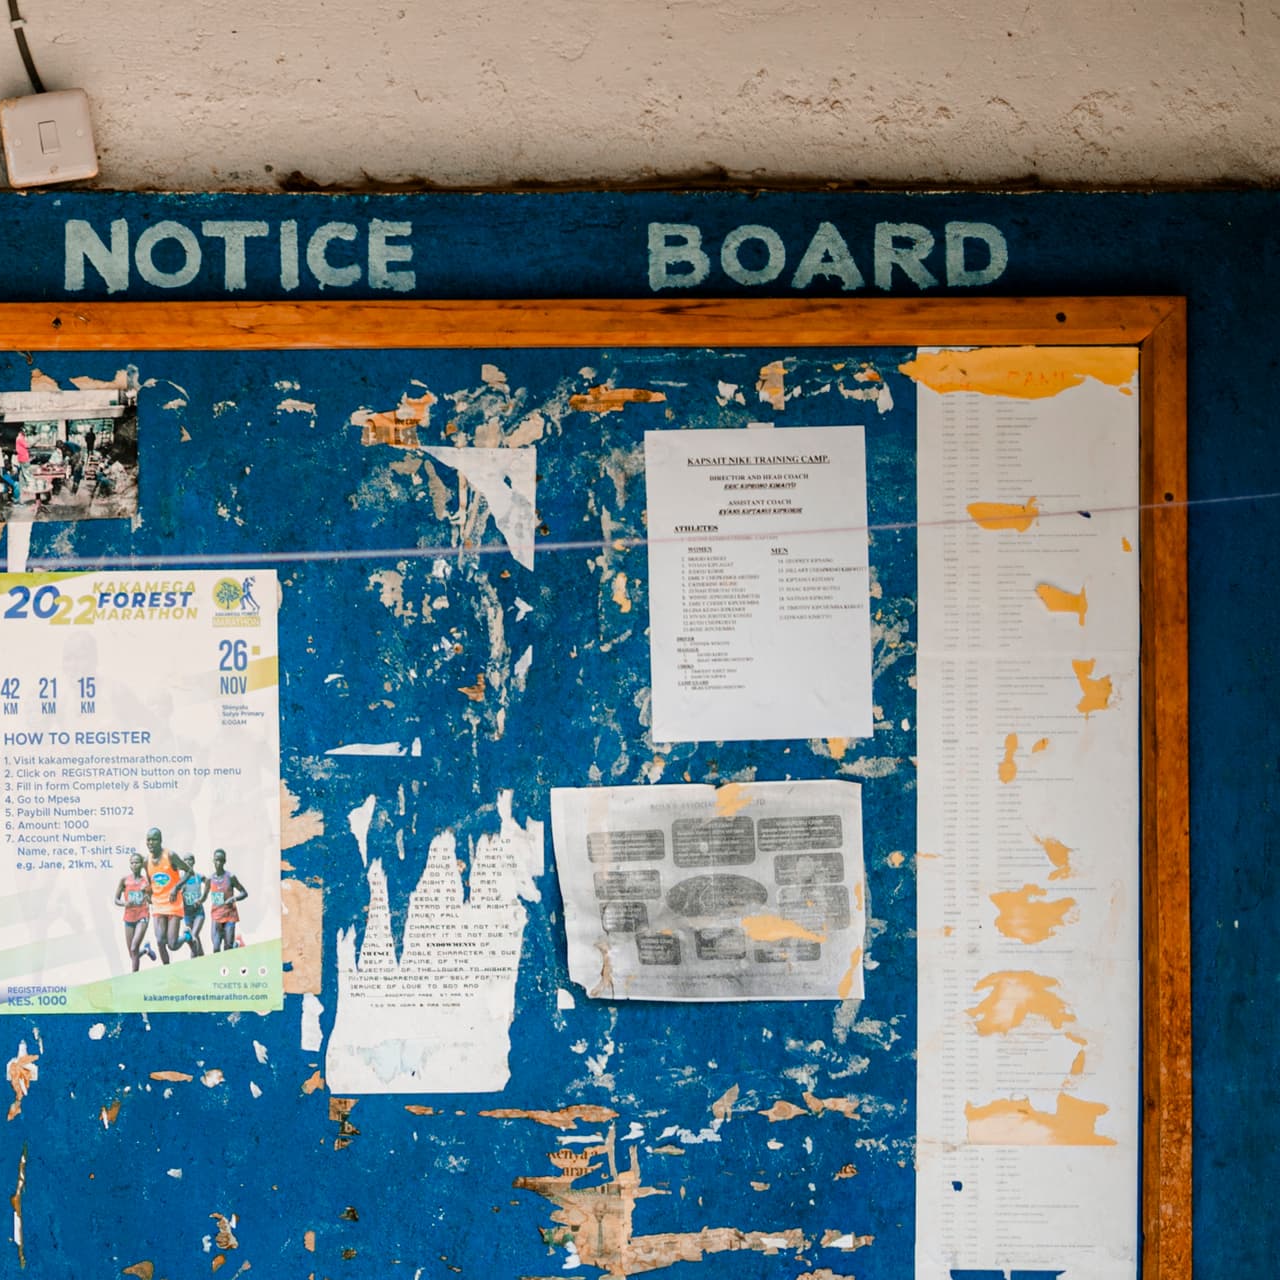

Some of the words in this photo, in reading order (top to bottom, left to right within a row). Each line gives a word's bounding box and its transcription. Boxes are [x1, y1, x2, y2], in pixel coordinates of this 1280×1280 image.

[63, 218, 417, 293] NOTICE
[646, 219, 1008, 292] BOARD
[687, 457, 726, 466] KAPSAIT
[728, 457, 752, 465] NIKE
[754, 456, 799, 464] TRAINING
[801, 455, 830, 464] CAMP.
[673, 525, 719, 533] ATHLETES
[92, 581, 196, 594] KAKAMEGA
[97, 592, 192, 608] FOREST
[91, 607, 198, 621] MARATHON
[219, 639, 248, 672] 26
[0, 678, 20, 700] 42
[39, 677, 57, 699] 21
[77, 676, 96, 699] 15
[220, 676, 247, 695] NOV
[3, 702, 19, 715] KM
[41, 702, 57, 714] KM
[80, 701, 96, 714] KM
[4, 733, 43, 746] HOW
[49, 732, 70, 746] TO
[75, 731, 151, 745] REGISTER
[4, 756, 11, 766] 1.
[13, 756, 36, 765] Visit
[38, 754, 193, 766] kakamegaforestmarathon.com
[4, 769, 13, 778] 2.
[16, 769, 40, 778] Click
[42, 770, 56, 778] on
[61, 768, 138, 777] REGISTRATION
[141, 767, 175, 776] button
[177, 768, 190, 776] on
[193, 767, 211, 777] top
[213, 768, 242, 776] menu
[5, 782, 14, 791] 3.
[16, 782, 31, 791] Fill
[34, 782, 43, 790] in
[46, 782, 70, 790] form
[72, 780, 130, 792] Completely
[132, 781, 140, 790] &
[143, 780, 178, 790] Submit
[5, 796, 14, 804] 4.
[17, 795, 32, 804] Go
[34, 796, 45, 804] to
[47, 794, 81, 805] Mpesa
[5, 808, 14, 817] 5.
[17, 808, 50, 818] Paybill
[53, 807, 97, 816] Number:
[100, 806, 134, 816] 511072
[5, 822, 14, 830] 6.
[18, 820, 60, 830] Amount:
[64, 820, 90, 830] 1000
[5, 834, 14, 843] 7.
[18, 834, 60, 843] Account
[62, 833, 106, 842] Number:
[17, 847, 50, 856] Name,
[52, 848, 78, 856] race,
[80, 846, 113, 855] T-shirt
[115, 846, 137, 855] Size
[16, 861, 36, 871] e.g.
[38, 860, 65, 870] Jane,
[68, 860, 97, 869] 21km,
[100, 860, 113, 868] XL
[7, 986, 67, 994] REGISTRATION
[8, 996, 34, 1006] KES.
[38, 995, 68, 1006] 1000
[143, 993, 269, 1002] kakamegaforestmarathon.com
